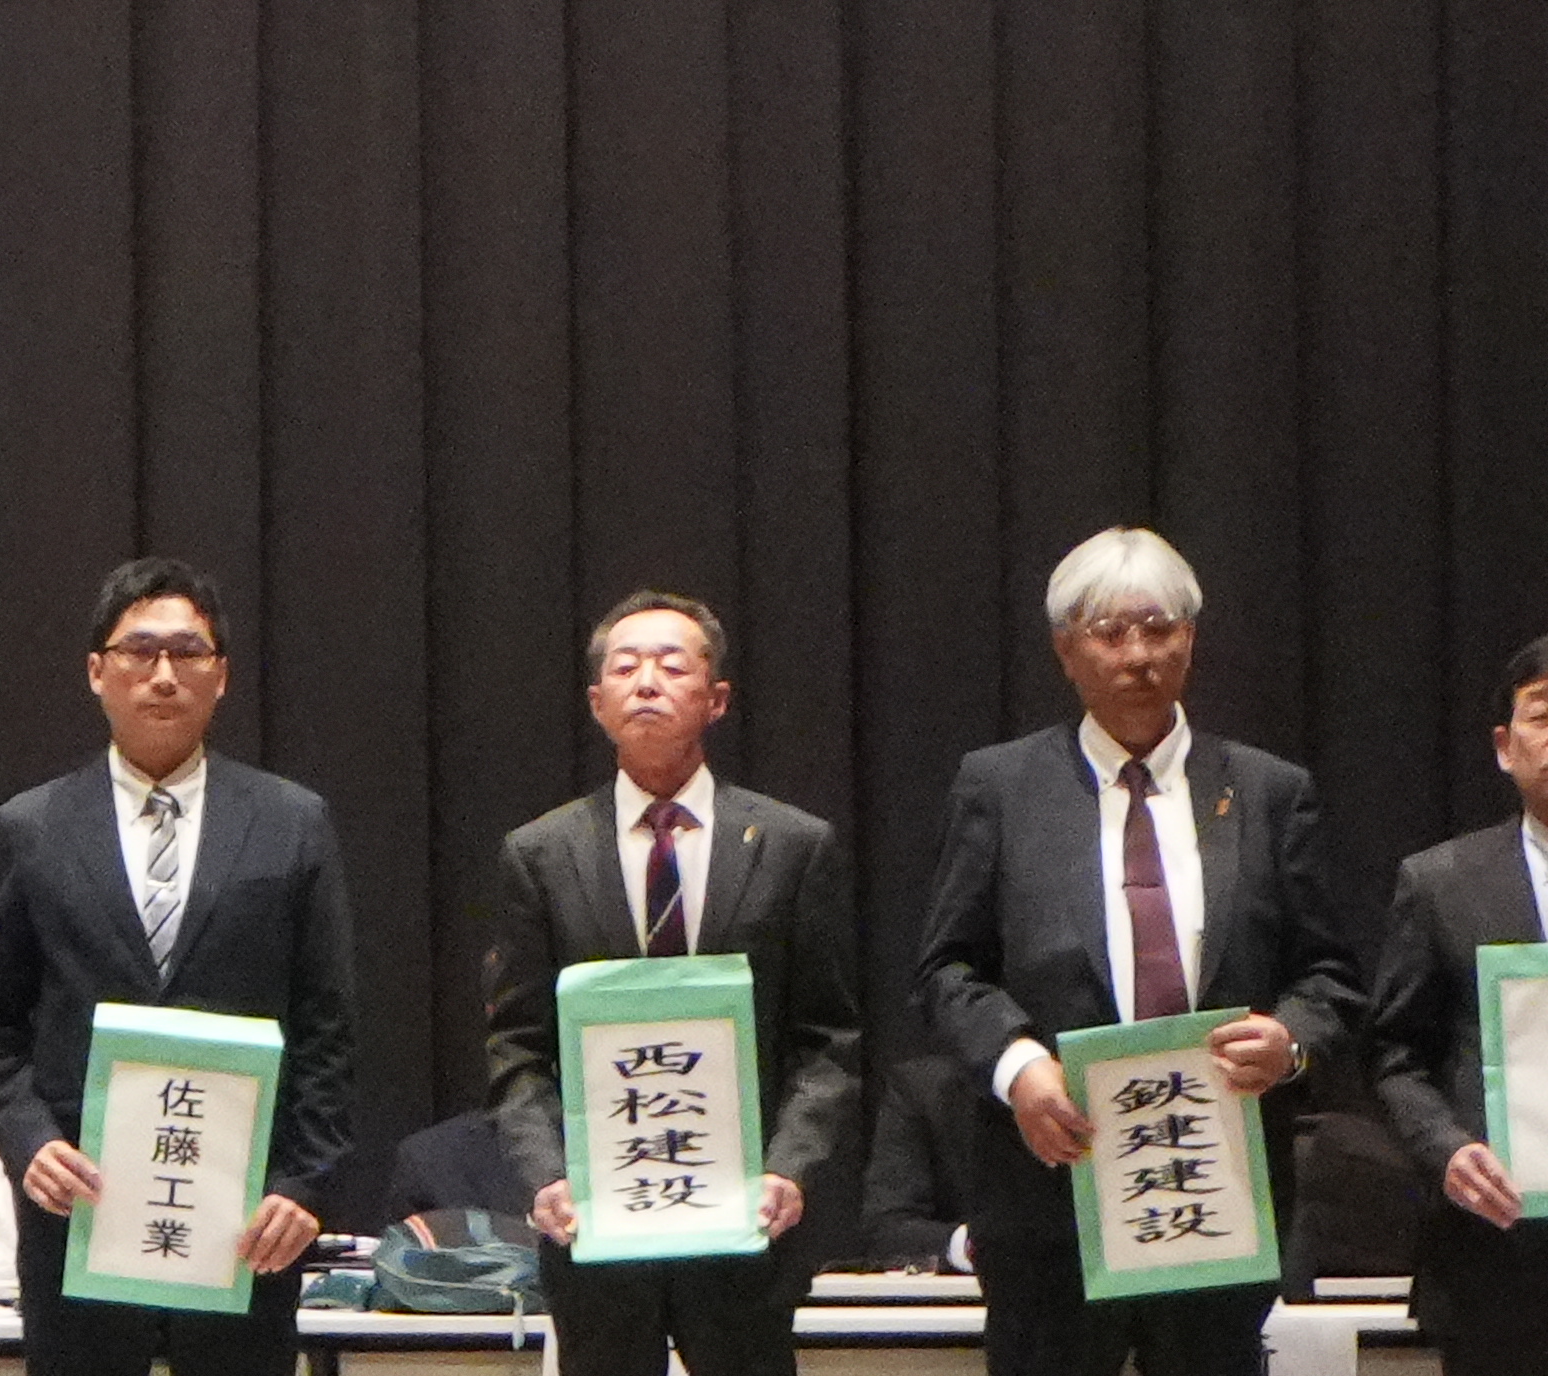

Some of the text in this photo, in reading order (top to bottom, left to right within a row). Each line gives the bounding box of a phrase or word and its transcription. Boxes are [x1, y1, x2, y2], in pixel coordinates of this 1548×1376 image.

[142, 1079, 207, 1261] 佐藤工業
[608, 1039, 717, 1214] 西松建設
[1109, 1071, 1233, 1245] 鉄建建設
